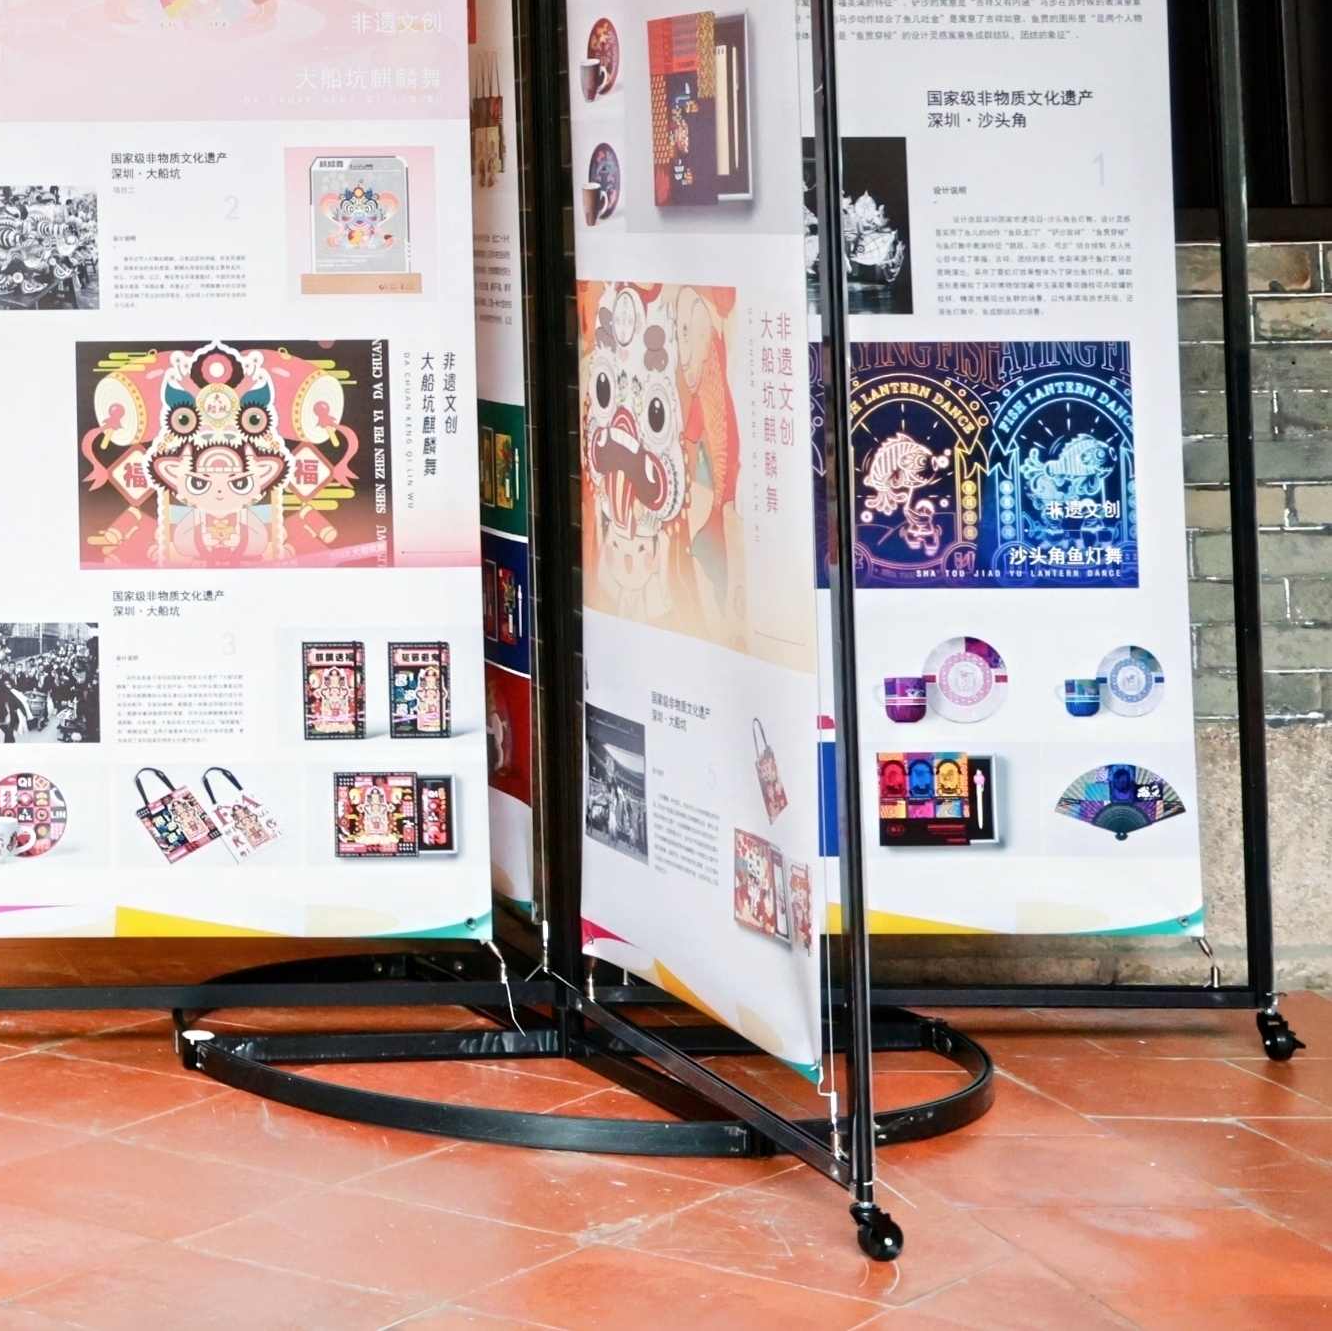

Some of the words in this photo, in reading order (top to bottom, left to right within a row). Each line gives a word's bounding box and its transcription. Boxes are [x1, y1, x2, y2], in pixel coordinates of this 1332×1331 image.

[351, 11, 442, 33] 非遗文创
[296, 67, 442, 90] 大船坑麒麟舞
[927, 90, 1093, 106] 国家级非物质文化遗产
[110, 152, 228, 165] 国家级非物质文化遗产
[1092, 152, 1105, 186] 1
[933, 186, 967, 195] 设计说明
[223, 196, 240, 220] 2
[372, 339, 383, 379] CHUAN
[776, 312, 795, 446] 非遗文创
[373, 382, 383, 400] DA
[443, 351, 458, 434] 非遗文创
[374, 409, 384, 423] YI
[421, 352, 437, 476] 大船坑麒麟舞
[760, 311, 779, 514] 大船坑麒麟舞
[862, 381, 930, 406] LANTERN
[931, 388, 976, 435] DANCE
[998, 395, 1027, 433] FISH
[1027, 381, 1095, 406] LANTERN
[374, 425, 385, 444] FEI
[405, 416, 413, 445] KENG
[123, 462, 148, 488] 福
[294, 459, 319, 485] 福
[375, 448, 386, 479] ZHEN
[376, 483, 387, 514] SHEN
[1046, 500, 1121, 520] 非遗文创
[1009, 546, 1123, 565] 沙头角鱼灯舞
[916, 569, 936, 578] SHA
[945, 569, 965, 578] TOU
[974, 569, 1001, 578] JIAO
[1009, 569, 1023, 578] YU
[1031, 569, 1079, 578] LANTERN
[1087, 569, 1122, 578] DANCE
[112, 590, 225, 602] 国家级非物质文化遗产
[222, 632, 237, 656] 3
[18, 777, 32, 788] QI
[50, 810, 66, 819] LIN
